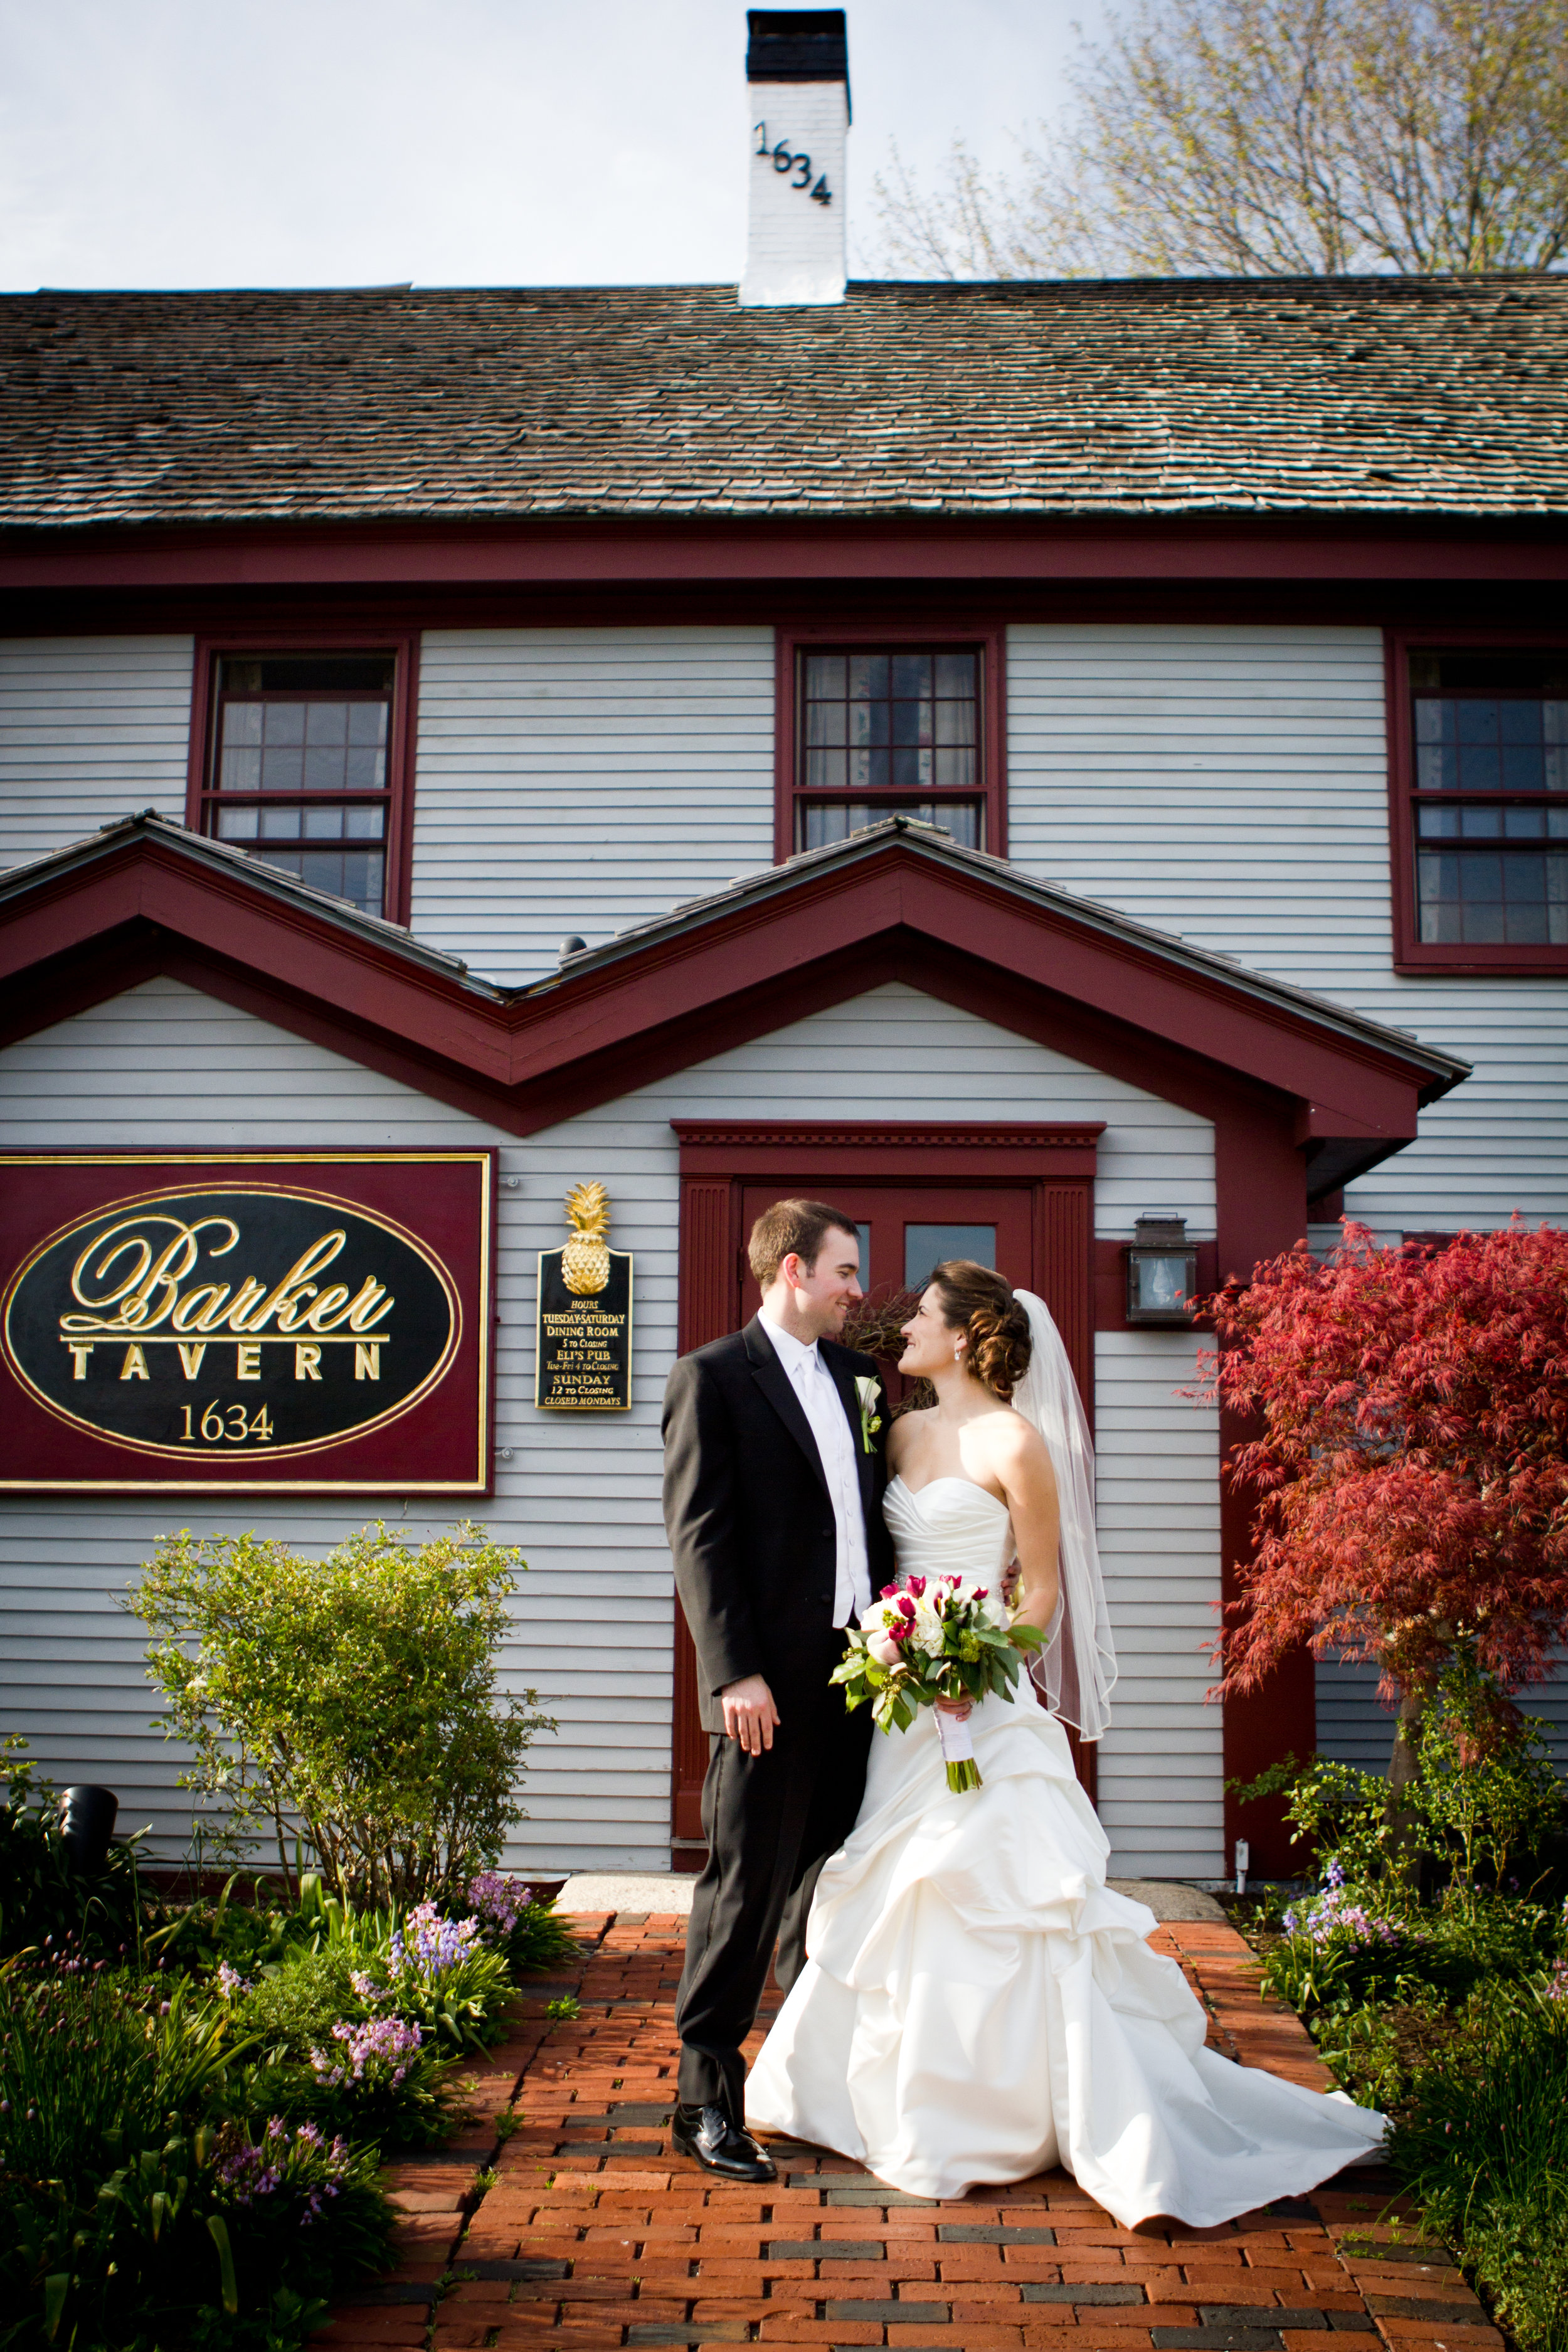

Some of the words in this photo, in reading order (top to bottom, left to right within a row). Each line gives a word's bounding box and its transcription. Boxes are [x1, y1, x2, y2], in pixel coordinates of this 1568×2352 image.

[754, 119, 832, 206] 1634
[60, 1213, 395, 1332] Barker
[571, 1300, 598, 1309] HOURS
[547, 1326, 584, 1336] DINING
[586, 1326, 618, 1336] ROOM
[563, 1338, 568, 1347] 5
[587, 1350, 610, 1360] PUB
[68, 1342, 380, 1380] TAVERN
[575, 1362, 580, 1370] 4
[553, 1375, 610, 1384] SUNDAY
[551, 1386, 563, 1394] 12
[179, 1399, 274, 1441] 1634
